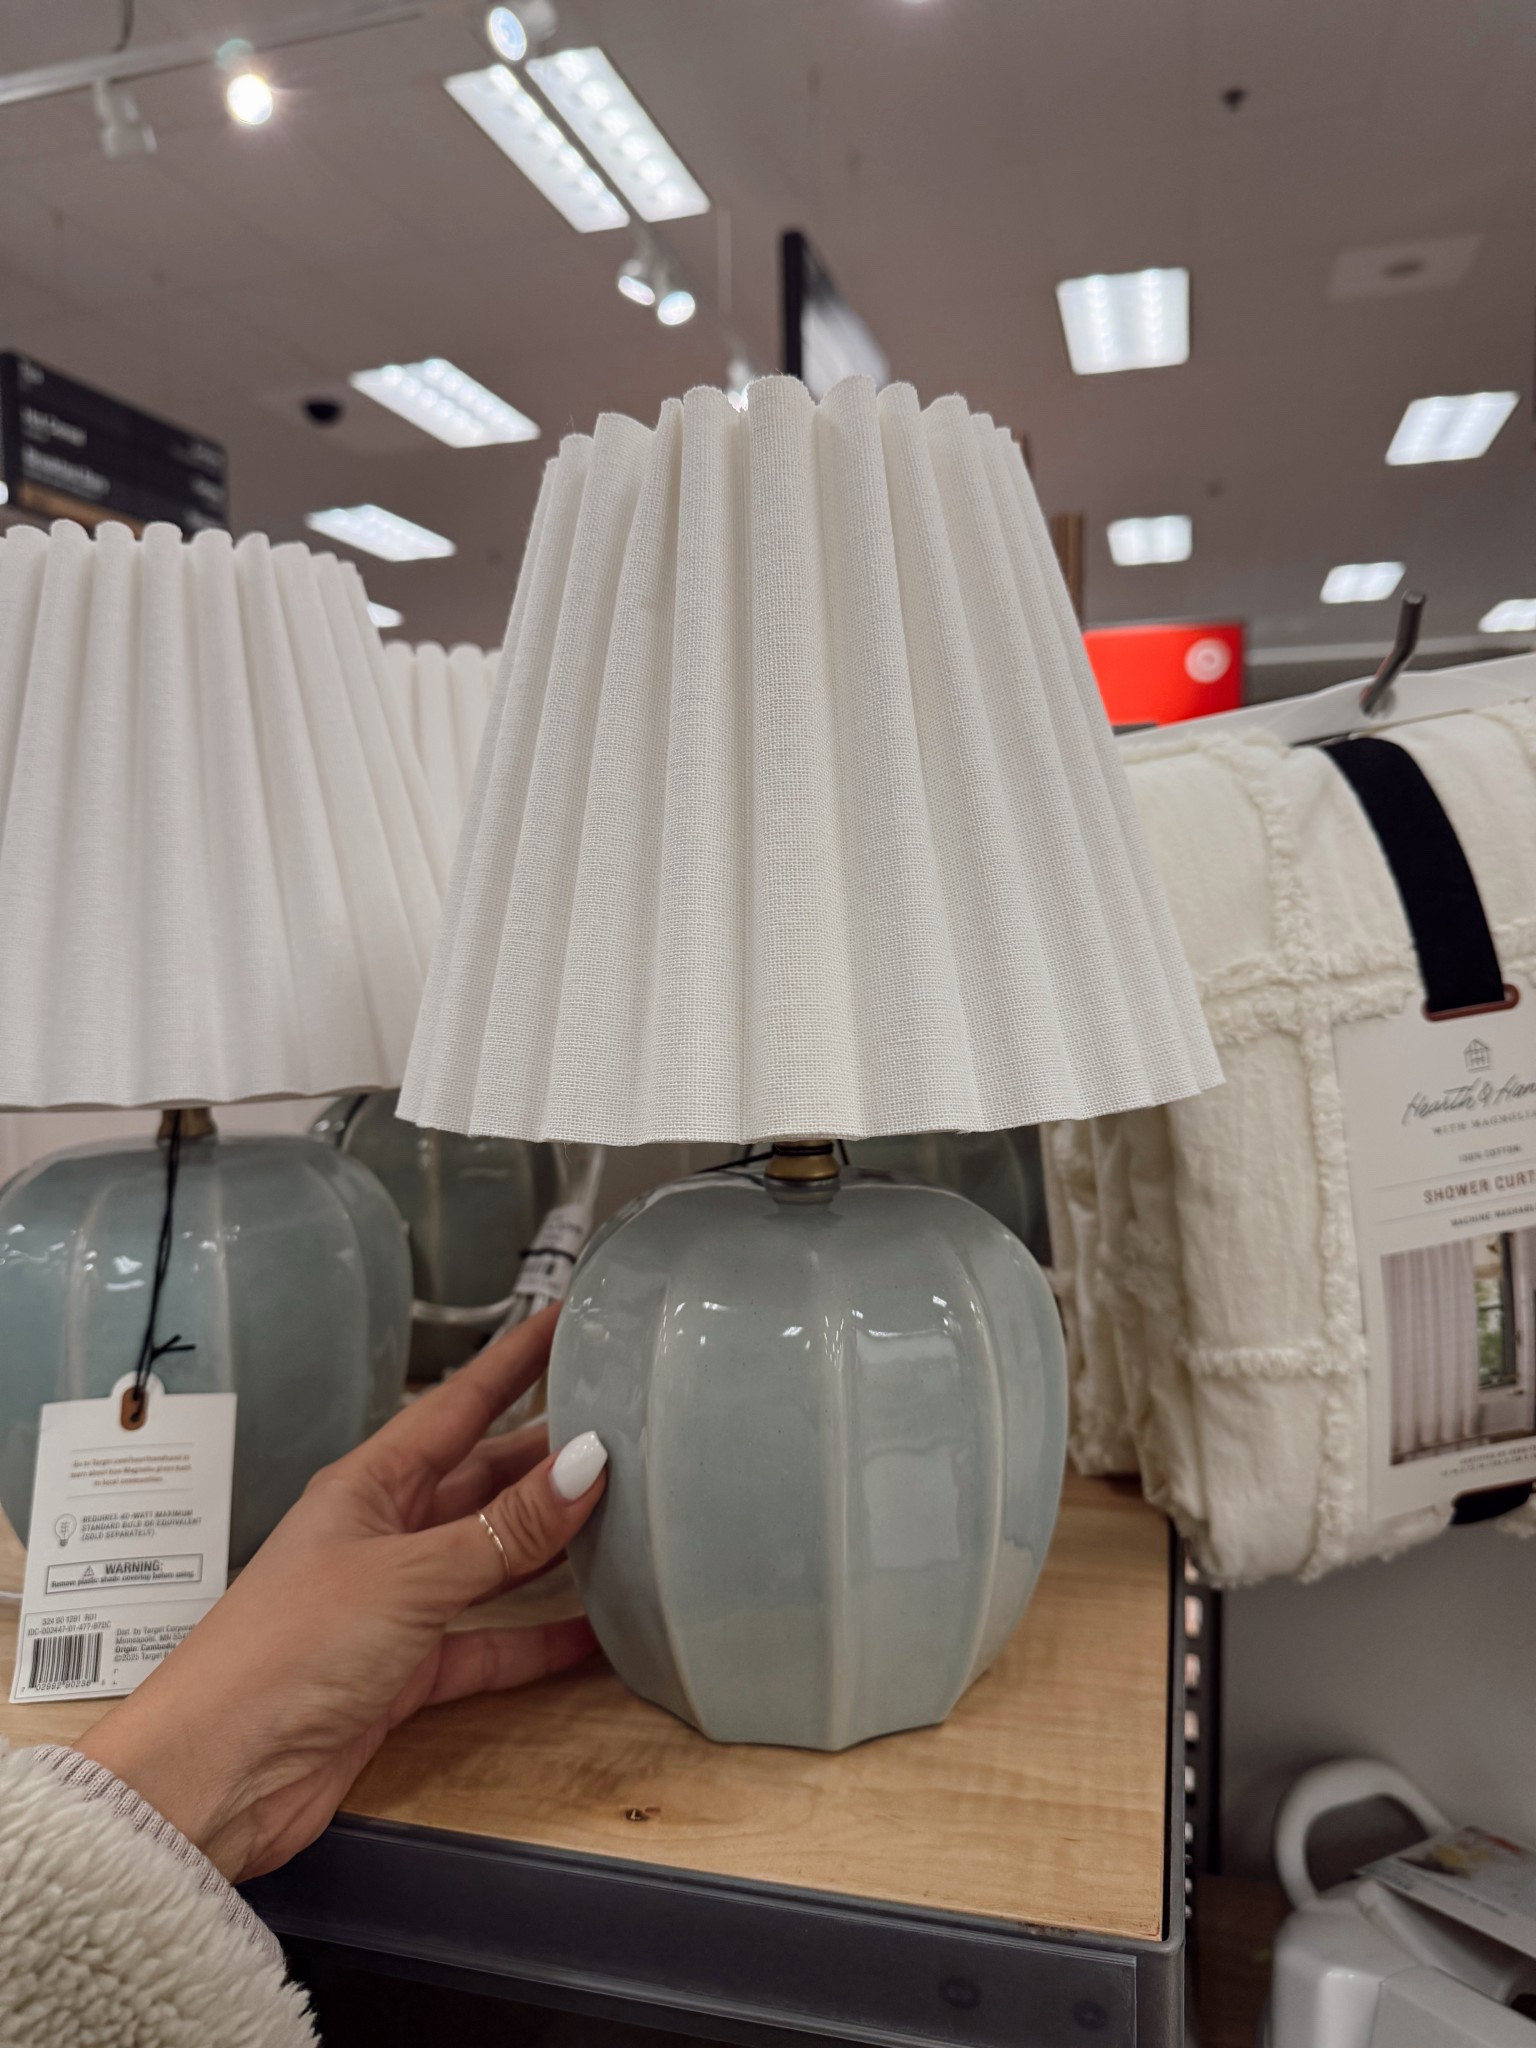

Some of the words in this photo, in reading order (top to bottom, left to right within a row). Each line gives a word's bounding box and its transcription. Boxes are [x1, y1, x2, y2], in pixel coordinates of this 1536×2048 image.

[1432, 1121, 1466, 1135] WITH
[1423, 1178, 1489, 1205] SHOWER
[81, 1521, 120, 1531] STANDARD
[156, 1516, 201, 1526] EQUIVALENT
[105, 1560, 163, 1574] WARNING:
[51, 1579, 76, 1588] Remove
[143, 1625, 164, 1635] Target
[141, 1650, 162, 1661] Target
